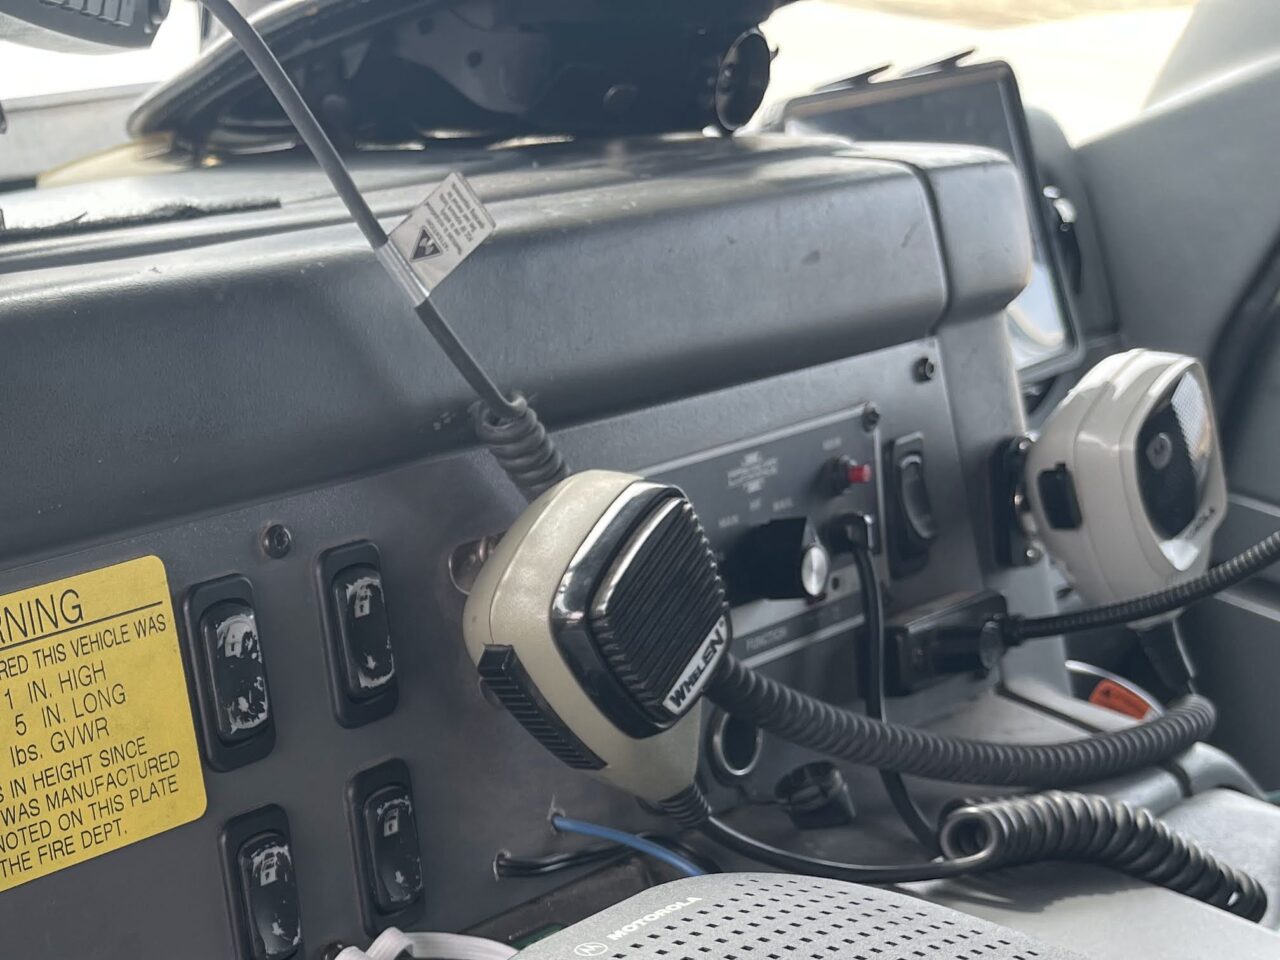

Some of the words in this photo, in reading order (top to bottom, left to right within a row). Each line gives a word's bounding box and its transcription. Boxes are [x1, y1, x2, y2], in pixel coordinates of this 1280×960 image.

[33, 644, 66, 671] THIS
[69, 625, 130, 658] VEHICLE
[134, 614, 167, 640] WAS
[669, 628, 724, 707] WHELEN
[4, 689, 13, 709] 1
[28, 678, 53, 704] IN.
[58, 660, 107, 688] HIGH
[15, 714, 27, 737] 5
[41, 703, 67, 728] IN.
[73, 683, 127, 715] LONG
[10, 740, 43, 768] lbs.
[50, 717, 110, 753] GVWR
[10, 777, 27, 800] IN
[33, 754, 93, 794] HEIGHT
[99, 736, 147, 767] SINCE
[0, 799, 41, 827] WAS
[45, 750, 181, 812] MANUFACTURED
[59, 807, 83, 832] ON
[89, 793, 125, 822] THIS
[129, 774, 180, 807] PLATE
[0, 854, 34, 880] THE
[37, 836, 77, 865] FIRE
[81, 818, 128, 850] DEPT.
[606, 897, 703, 941] MOTOROLA
